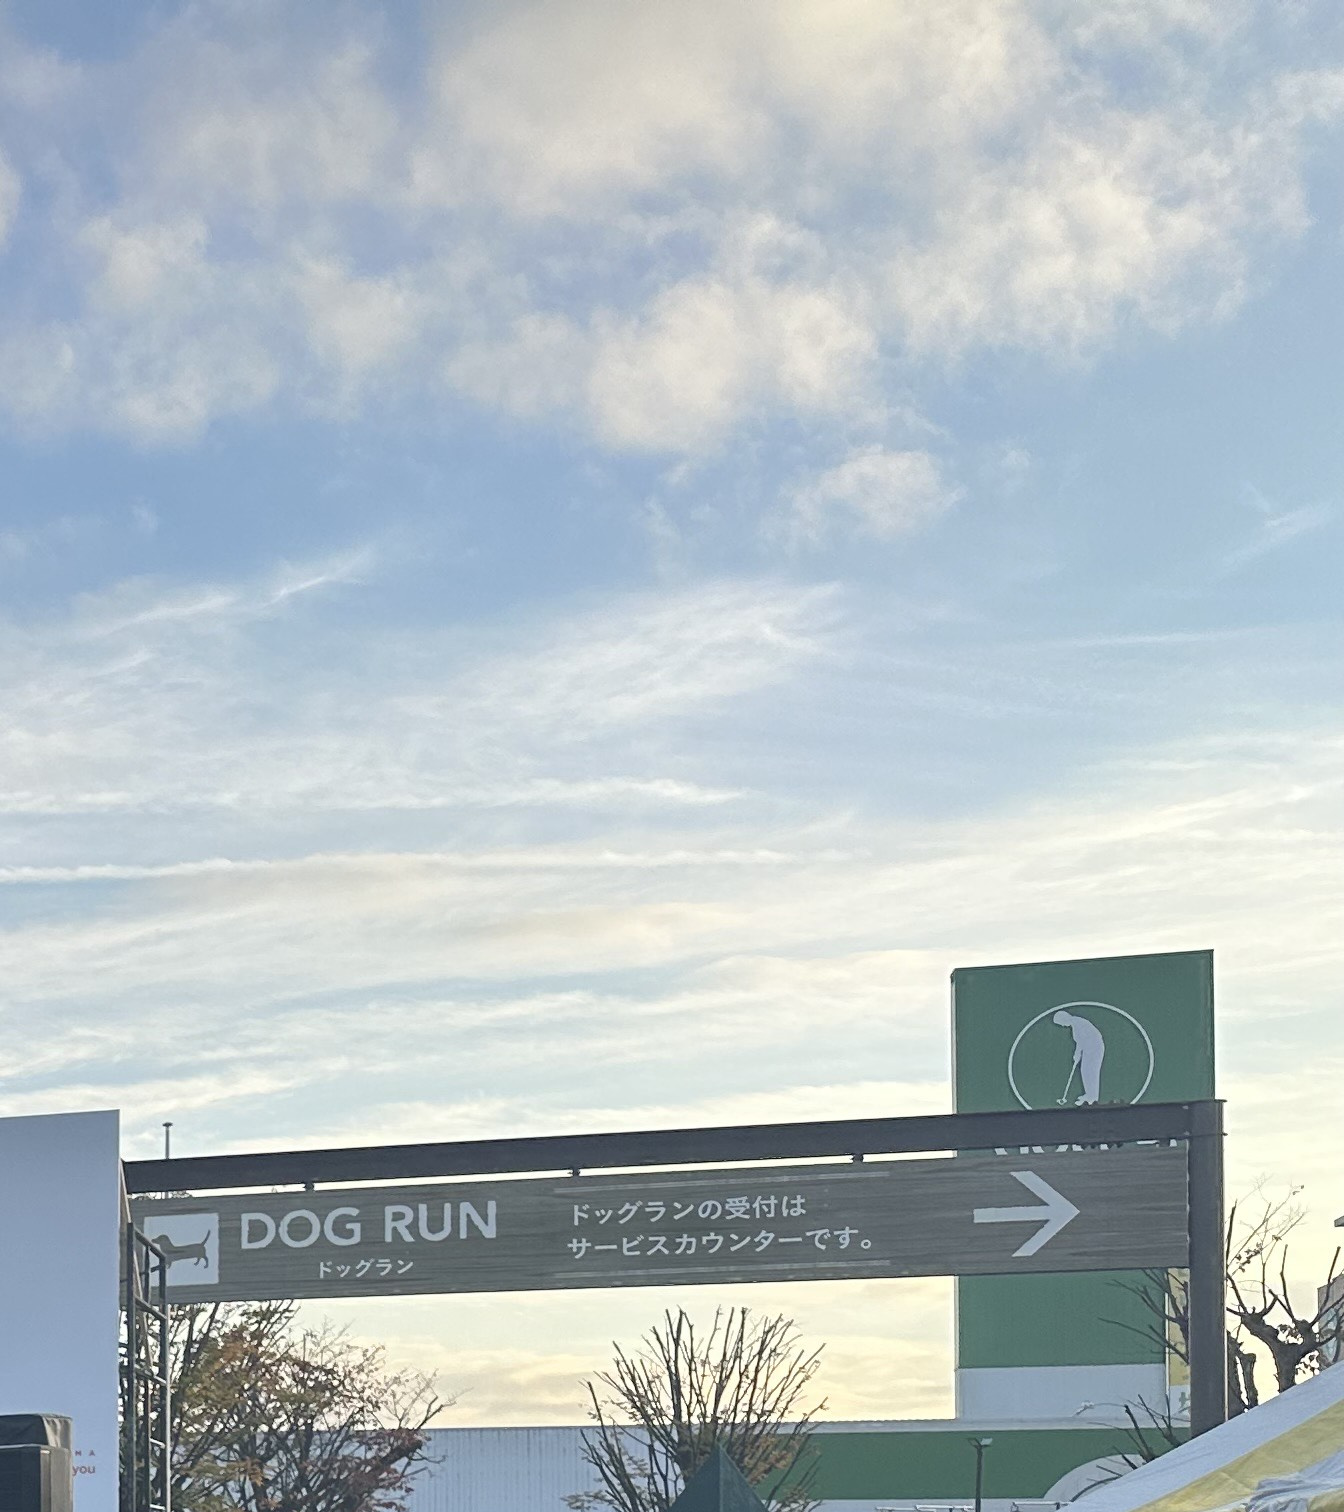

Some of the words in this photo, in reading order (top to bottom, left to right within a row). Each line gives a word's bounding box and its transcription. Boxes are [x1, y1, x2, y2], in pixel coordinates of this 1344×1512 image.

[241, 1207, 361, 1251] DOG
[383, 1200, 496, 1243] RUN
[572, 1195, 807, 1226] ドッグランの受付は
[567, 1225, 874, 1260] サービスカウンターです。
[319, 1260, 414, 1279] ドッグラン
